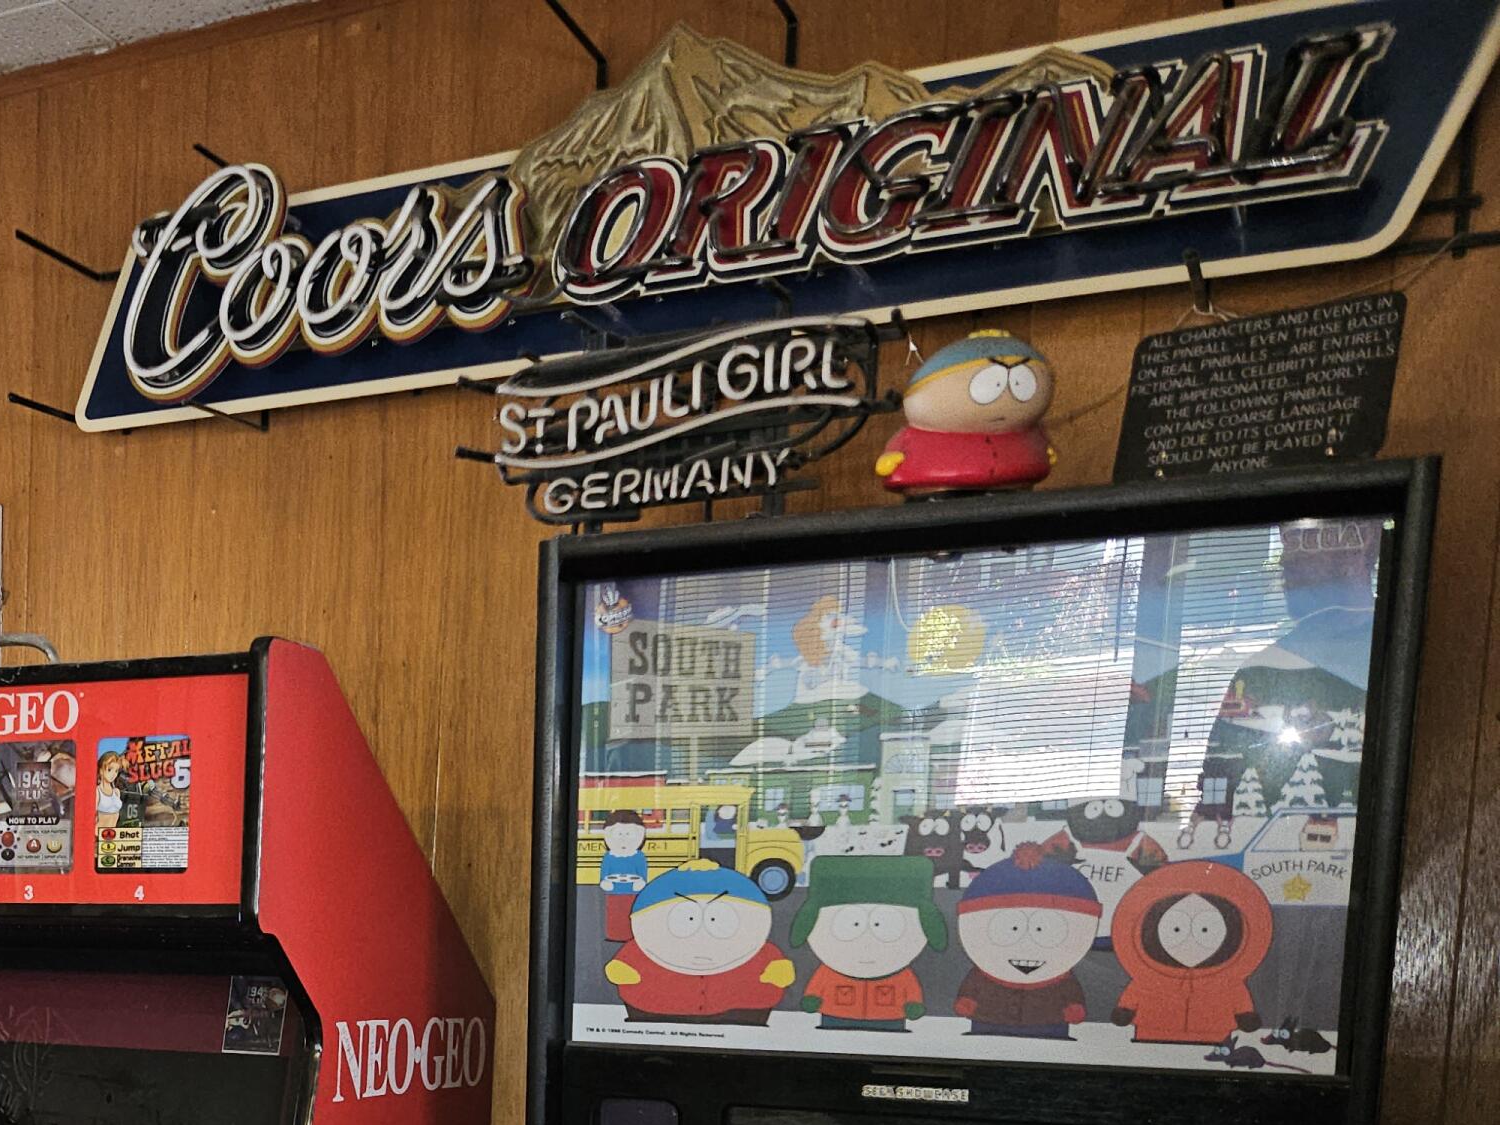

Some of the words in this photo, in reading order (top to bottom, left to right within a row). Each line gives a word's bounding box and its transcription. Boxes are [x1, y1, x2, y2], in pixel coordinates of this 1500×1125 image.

[124, 162, 532, 404] Coors
[551, 22, 1397, 305] ORIGINAL
[1140, 351, 1169, 365] THIS
[1172, 342, 1227, 361] PINBALL
[1250, 332, 1288, 348] EVEN
[1295, 322, 1343, 341] THOSE
[1348, 311, 1399, 330] BASED
[1151, 335, 1175, 349] ALL
[1179, 319, 1272, 343] CHARACTERS
[1278, 311, 1309, 326] AND
[1313, 300, 1372, 322] EVENTS
[1378, 296, 1393, 310] IN
[1137, 368, 1157, 381] ON
[1161, 361, 1194, 377] REAL
[1201, 350, 1267, 370] PINBALLS
[1290, 341, 1317, 355] ARE
[1322, 328, 1393, 350] ENTIRELY
[1209, 369, 1235, 383] ALL
[1241, 356, 1317, 379] CELEBRITY
[1322, 344, 1396, 366] PINBALLS
[567, 361, 704, 451] PAULI
[718, 338, 850, 401] GIRL
[1149, 394, 1174, 408] ARE
[1165, 406, 1190, 419] THE
[1196, 393, 1278, 415] FOLLOWING
[1284, 384, 1344, 401] PINBALL
[1144, 419, 1214, 437] CONTAINS
[1219, 408, 1275, 427] COARSE
[1280, 396, 1362, 419] LANGUAGE
[1146, 436, 1175, 451] AND
[1181, 433, 1207, 447] DUE
[1215, 430, 1233, 443] TO
[1236, 425, 1259, 439] ITS
[1265, 416, 1333, 436] CONTENT
[1207, 443, 1237, 459] NOT
[1243, 440, 1260, 454] BE
[1265, 431, 1322, 451] PLAYED
[543, 447, 790, 514] GERMANY
[628, 631, 743, 679] SOUTH
[625, 682, 740, 724] PARK
[126, 739, 191, 763] METAL
[128, 762, 174, 783] SLUG
[9, 817, 25, 825] HOW
[39, 817, 57, 825] PLAY
[119, 831, 140, 839] Shot
[117, 844, 140, 853] Jump
[1080, 864, 1126, 882] CHEF
[1250, 860, 1303, 881] SOUTH
[1308, 860, 1348, 880] PARK
[24, 885, 33, 900] 3
[134, 885, 144, 900] 4
